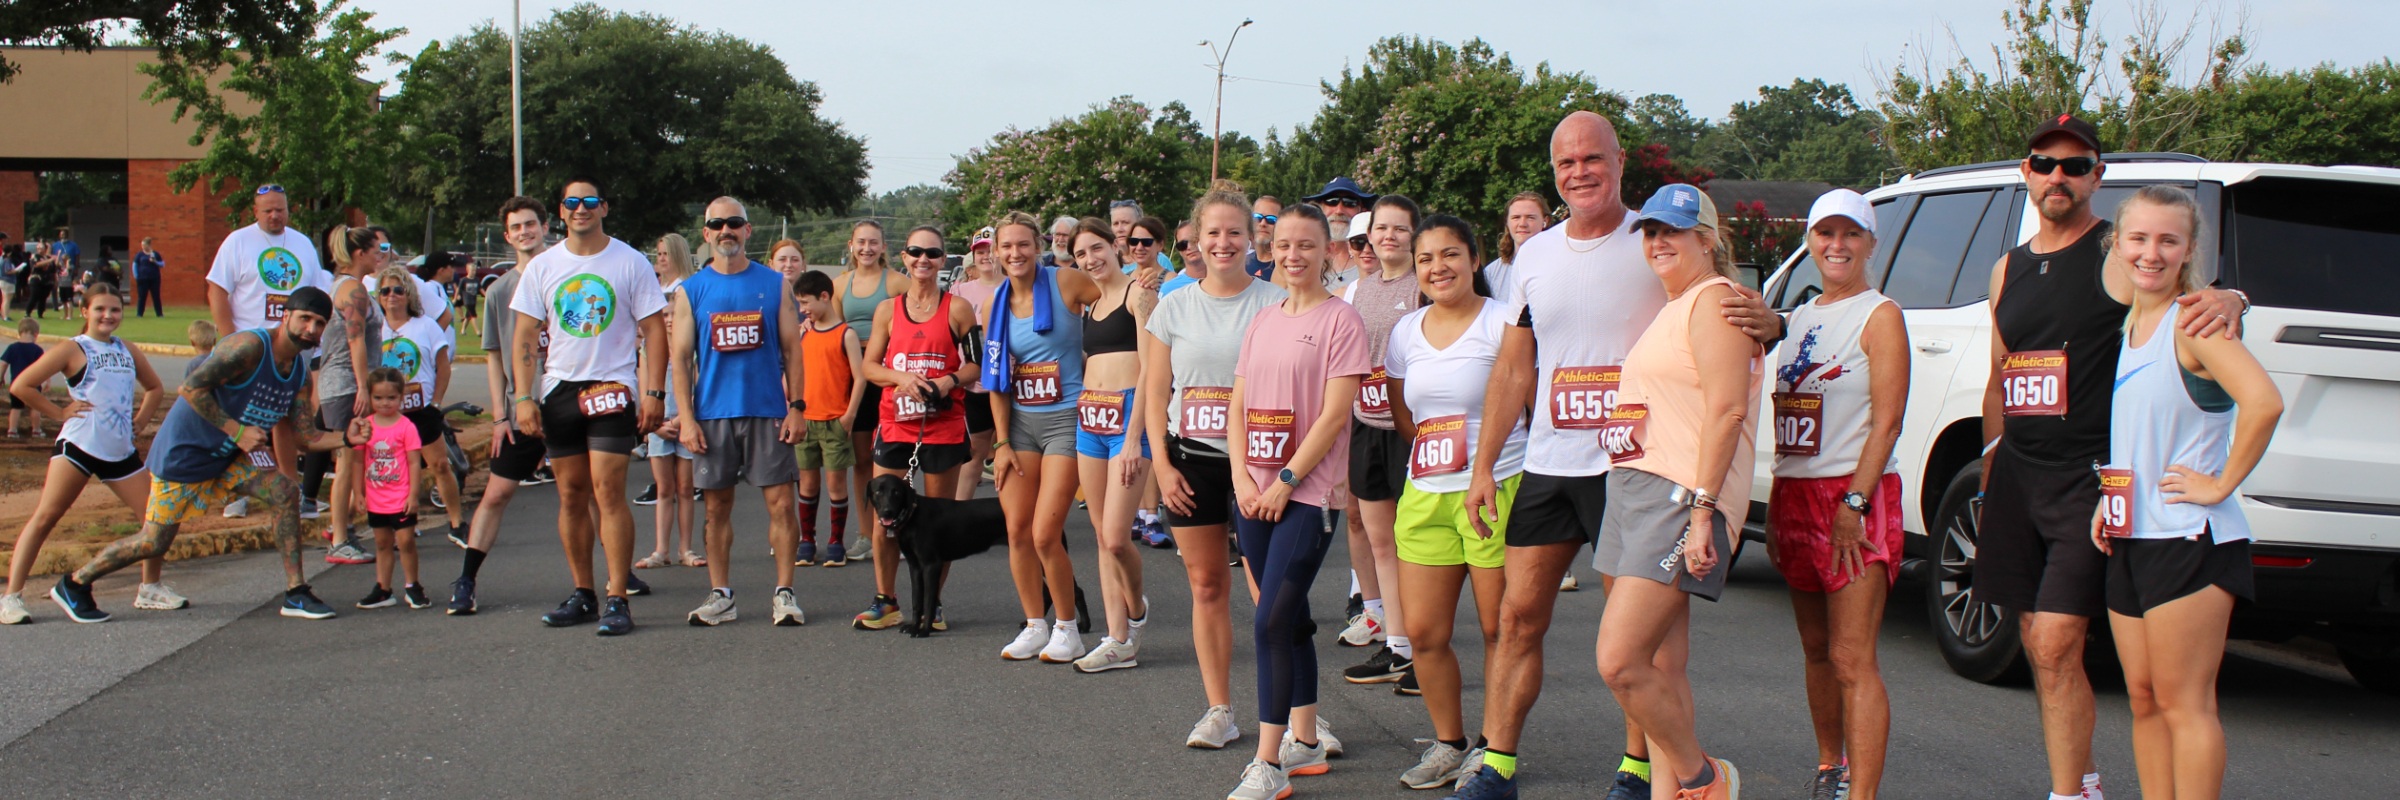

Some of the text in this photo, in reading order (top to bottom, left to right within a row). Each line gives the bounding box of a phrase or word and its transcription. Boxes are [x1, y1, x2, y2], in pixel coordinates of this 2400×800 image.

[267, 303, 284, 318] 16
[716, 325, 759, 346] 1565
[907, 360, 945, 370] RUNNING
[1015, 377, 1058, 399] 1644
[2003, 375, 2058, 407] 1650
[400, 393, 421, 409] 58
[584, 391, 628, 416] 1564
[1556, 390, 1619, 420] 1559
[1080, 406, 1120, 429] 1642
[1185, 405, 1229, 430] 165
[1248, 431, 1290, 459] 1557
[1600, 426, 1636, 454] 1560
[248, 451, 275, 467] 1631
[1417, 437, 1453, 468] 460
